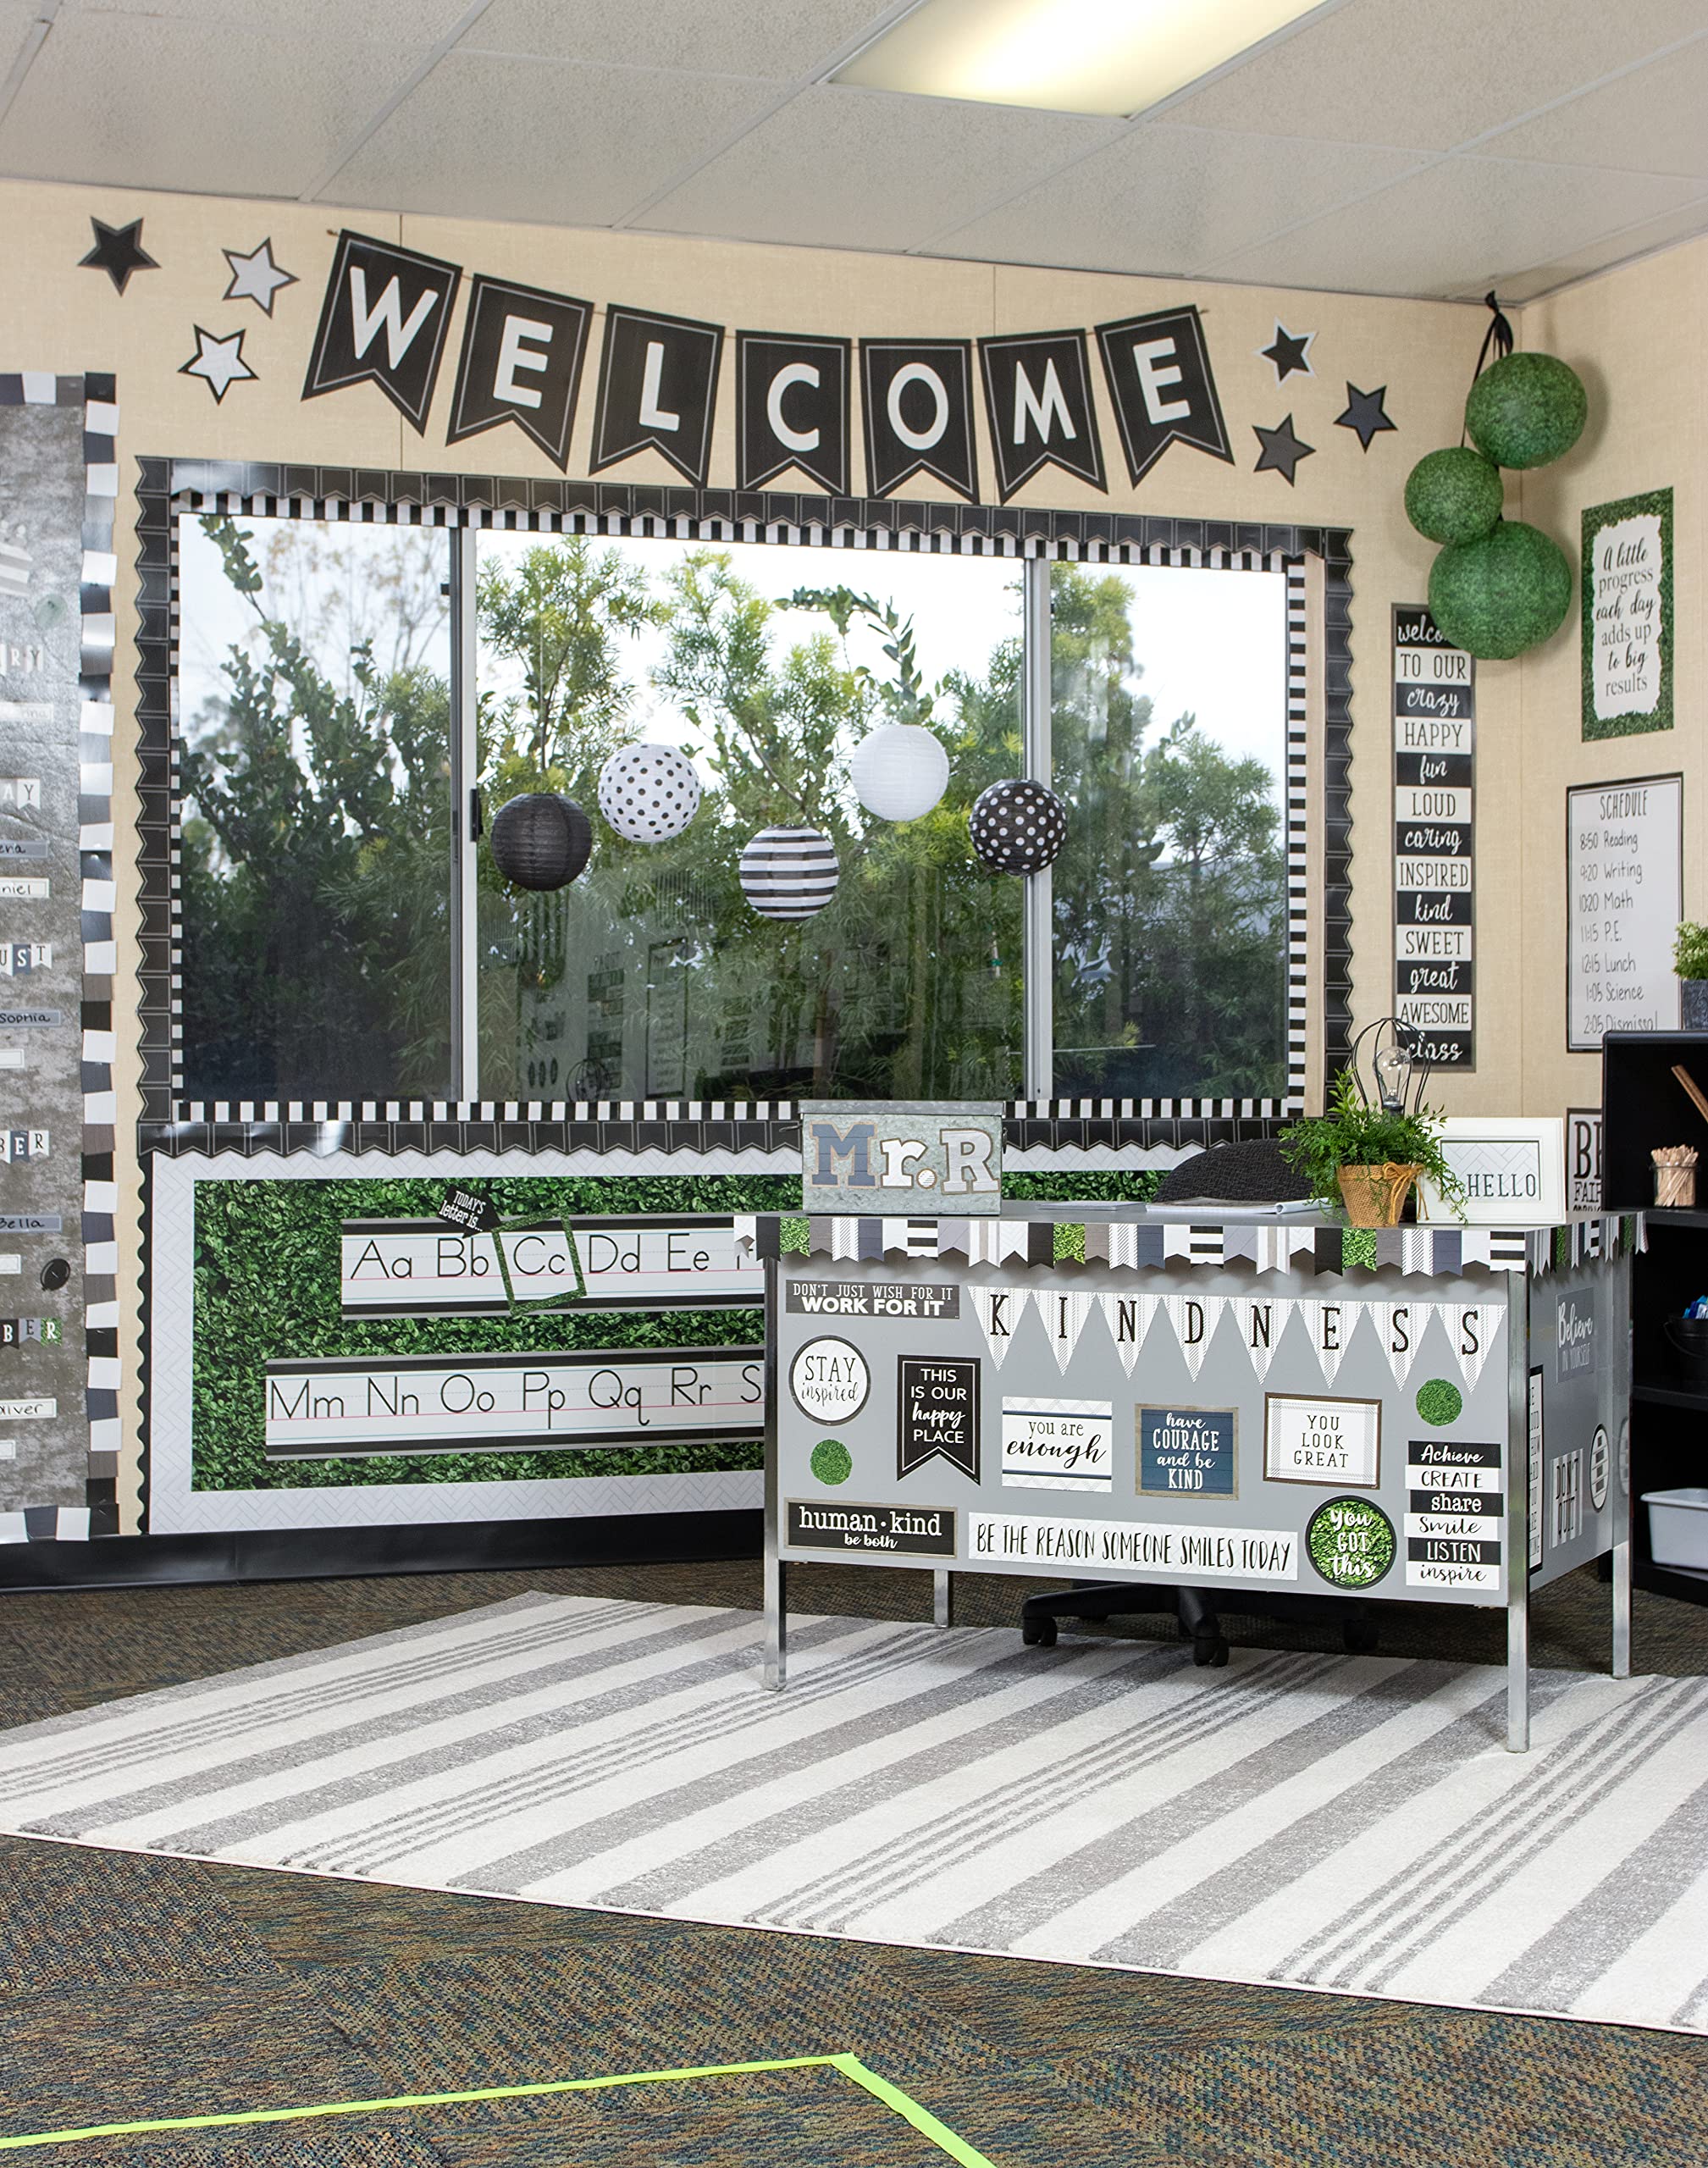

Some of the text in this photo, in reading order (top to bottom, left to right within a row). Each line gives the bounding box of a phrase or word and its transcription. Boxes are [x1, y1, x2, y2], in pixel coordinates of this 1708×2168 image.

[350, 265, 1191, 451] WELCOME
[1617, 537, 1648, 568] little
[1598, 566, 1654, 598] progress
[1595, 595, 1657, 622] each day
[1398, 614, 1448, 643] welco
[1600, 622, 1652, 648] adds up
[1401, 653, 1467, 679] TO OUR
[1608, 644, 1648, 673] to big
[1605, 673, 1647, 697] results
[1407, 687, 1460, 716] crazy
[1404, 722, 1463, 747] HAPPY
[1419, 755, 1447, 785] fun
[1412, 793, 1456, 817] LOUD
[1600, 789, 1649, 821] SCHEDULE
[1404, 827, 1462, 855] caring
[1579, 831, 1638, 854] 8:50 Reading
[1400, 863, 1469, 888] INSPIRED
[1580, 861, 1643, 885] 9:20 Writing
[1414, 893, 1453, 921] kind
[1604, 889, 1633, 911] Math
[1406, 931, 1464, 955] SWEET
[1605, 921, 1622, 942] P.E.
[1605, 951, 1636, 973] Lunch
[1409, 960, 1460, 994] great
[1586, 982, 1644, 1002] 1:05 Science
[1401, 1002, 1469, 1024] AWESOME
[1584, 1015, 1604, 1034] 2:05
[1406, 1031, 1463, 1061] class
[1467, 1174, 1537, 1197] HELLO
[439, 1200, 468, 1224] letter
[454, 1190, 487, 1214] TODAY'S
[350, 1239, 412, 1280] Aa
[437, 1237, 489, 1277] Bb
[513, 1236, 566, 1275] Cc
[589, 1234, 641, 1274] Dd
[667, 1233, 710, 1273] Ee
[793, 1283, 953, 1301] DON'T JUST WISH FOR IT
[801, 1297, 944, 1316] WORK FOR IT
[989, 1293, 1479, 1355] KINDNESS
[1557, 1302, 1593, 1348] Believe
[804, 1355, 857, 1383] STAY
[920, 1369, 957, 1382] THIS
[271, 1378, 344, 1420] Mm
[368, 1375, 419, 1417] Nn
[440, 1374, 495, 1413] Oo
[522, 1372, 565, 1430] Pp
[589, 1369, 650, 1426] Qq
[672, 1367, 711, 1406] Rr
[800, 1382, 860, 1407] inspired
[910, 1385, 967, 1401] IS OUR
[912, 1402, 965, 1430] happy
[1166, 1412, 1207, 1428] have
[1307, 1414, 1340, 1431] YOU
[913, 1429, 965, 1444] PLACE
[1028, 1420, 1084, 1439] you are
[1152, 1428, 1220, 1452] COURAGE
[1301, 1432, 1344, 1450] LOOK
[1006, 1434, 1107, 1469] enough
[1156, 1452, 1216, 1468] and be
[1293, 1450, 1349, 1468] GREAT
[1421, 1444, 1484, 1464] Achieve
[1168, 1468, 1203, 1490] KIND
[1421, 1471, 1483, 1488] CREATE
[1431, 1493, 1483, 1513] share
[1419, 1516, 1482, 1535] Smile
[844, 1534, 898, 1549] be both
[976, 1524, 1291, 1571] BE THE REASON SOMEONE SMILES TODAY
[1337, 1531, 1369, 1553] GOT
[1427, 1541, 1481, 1562] LISTEN
[1328, 1555, 1376, 1579] this
[1420, 1564, 1487, 1585] inspire
